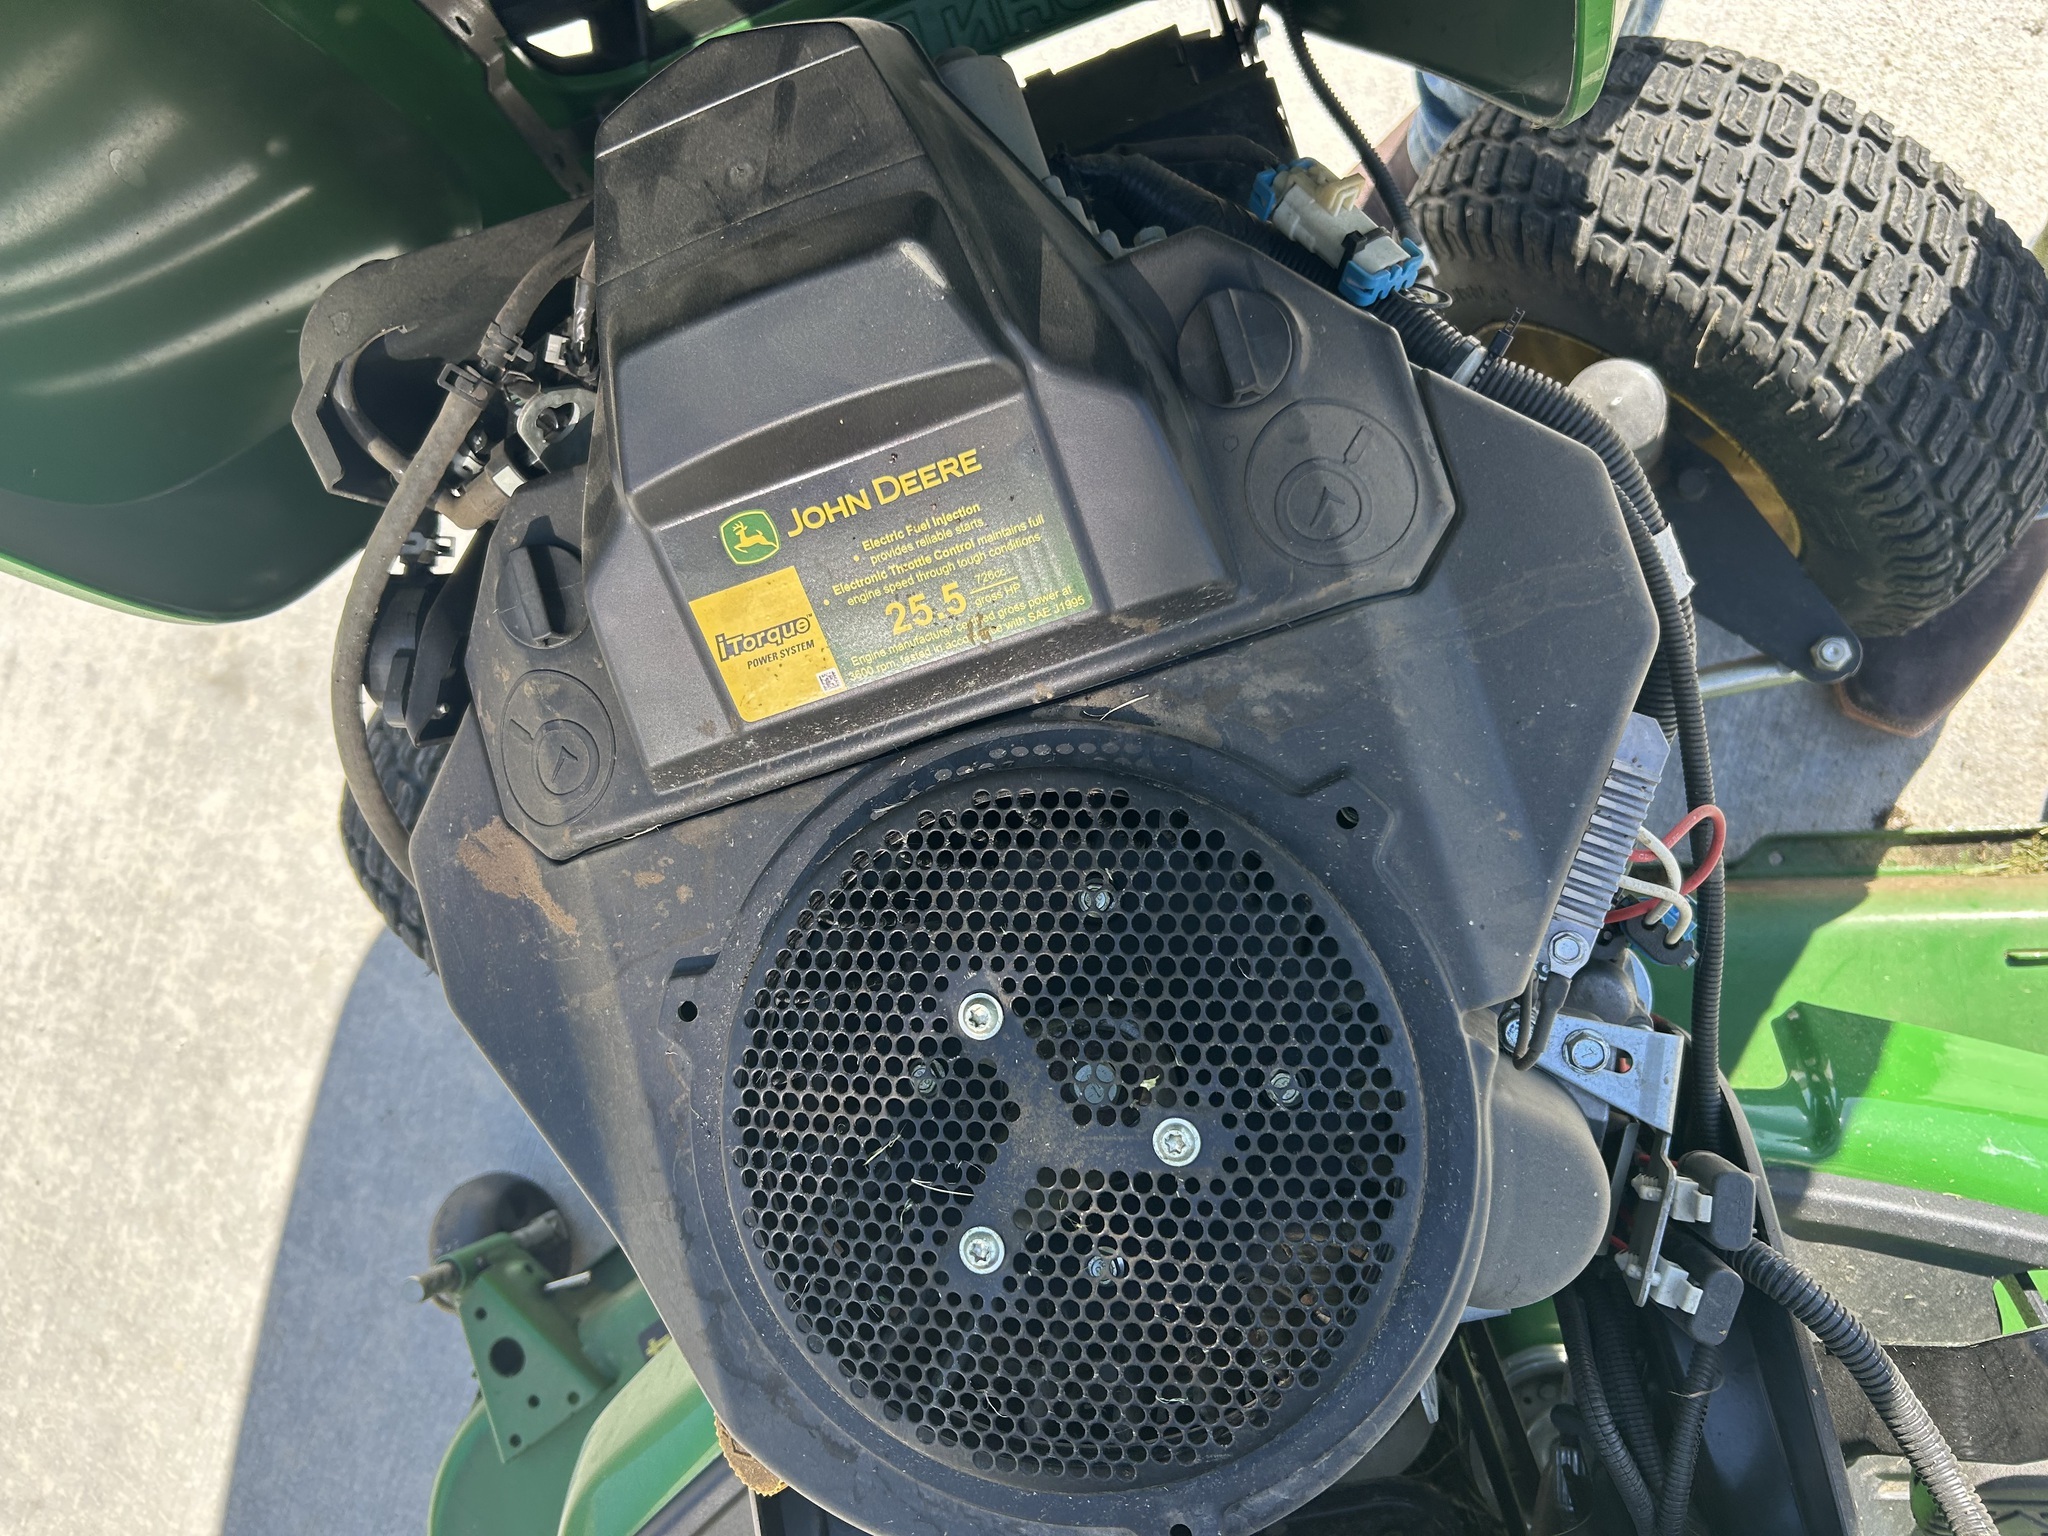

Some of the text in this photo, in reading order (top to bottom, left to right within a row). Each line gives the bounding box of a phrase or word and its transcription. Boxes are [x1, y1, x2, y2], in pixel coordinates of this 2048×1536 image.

[787, 448, 983, 538] JOHN DEERE
[862, 503, 981, 552] Electric Fuel Injection
[870, 518, 985, 567] provides reliable starts
[831, 513, 1046, 596] Electronic Throttle Control maintains full
[847, 533, 1041, 606] engine speed through tough conditions
[974, 568, 1007, 585] 726cc
[885, 581, 967, 637] 25.5
[974, 582, 1021, 608] gross HP
[715, 616, 811, 662] iTorque
[847, 666, 875, 682] 3600
[900, 646, 931, 664] tested
[933, 642, 944, 654] in
[1004, 614, 1027, 631] with
[1027, 606, 1052, 623] SAE
[1053, 594, 1086, 615] J1995
[850, 647, 887, 667] Engine
[887, 625, 953, 654] manufacturer
[997, 601, 1027, 620] gross
[1027, 590, 1059, 611] power
[1061, 584, 1073, 596] at
[747, 639, 816, 670] POWER SYSTEM
